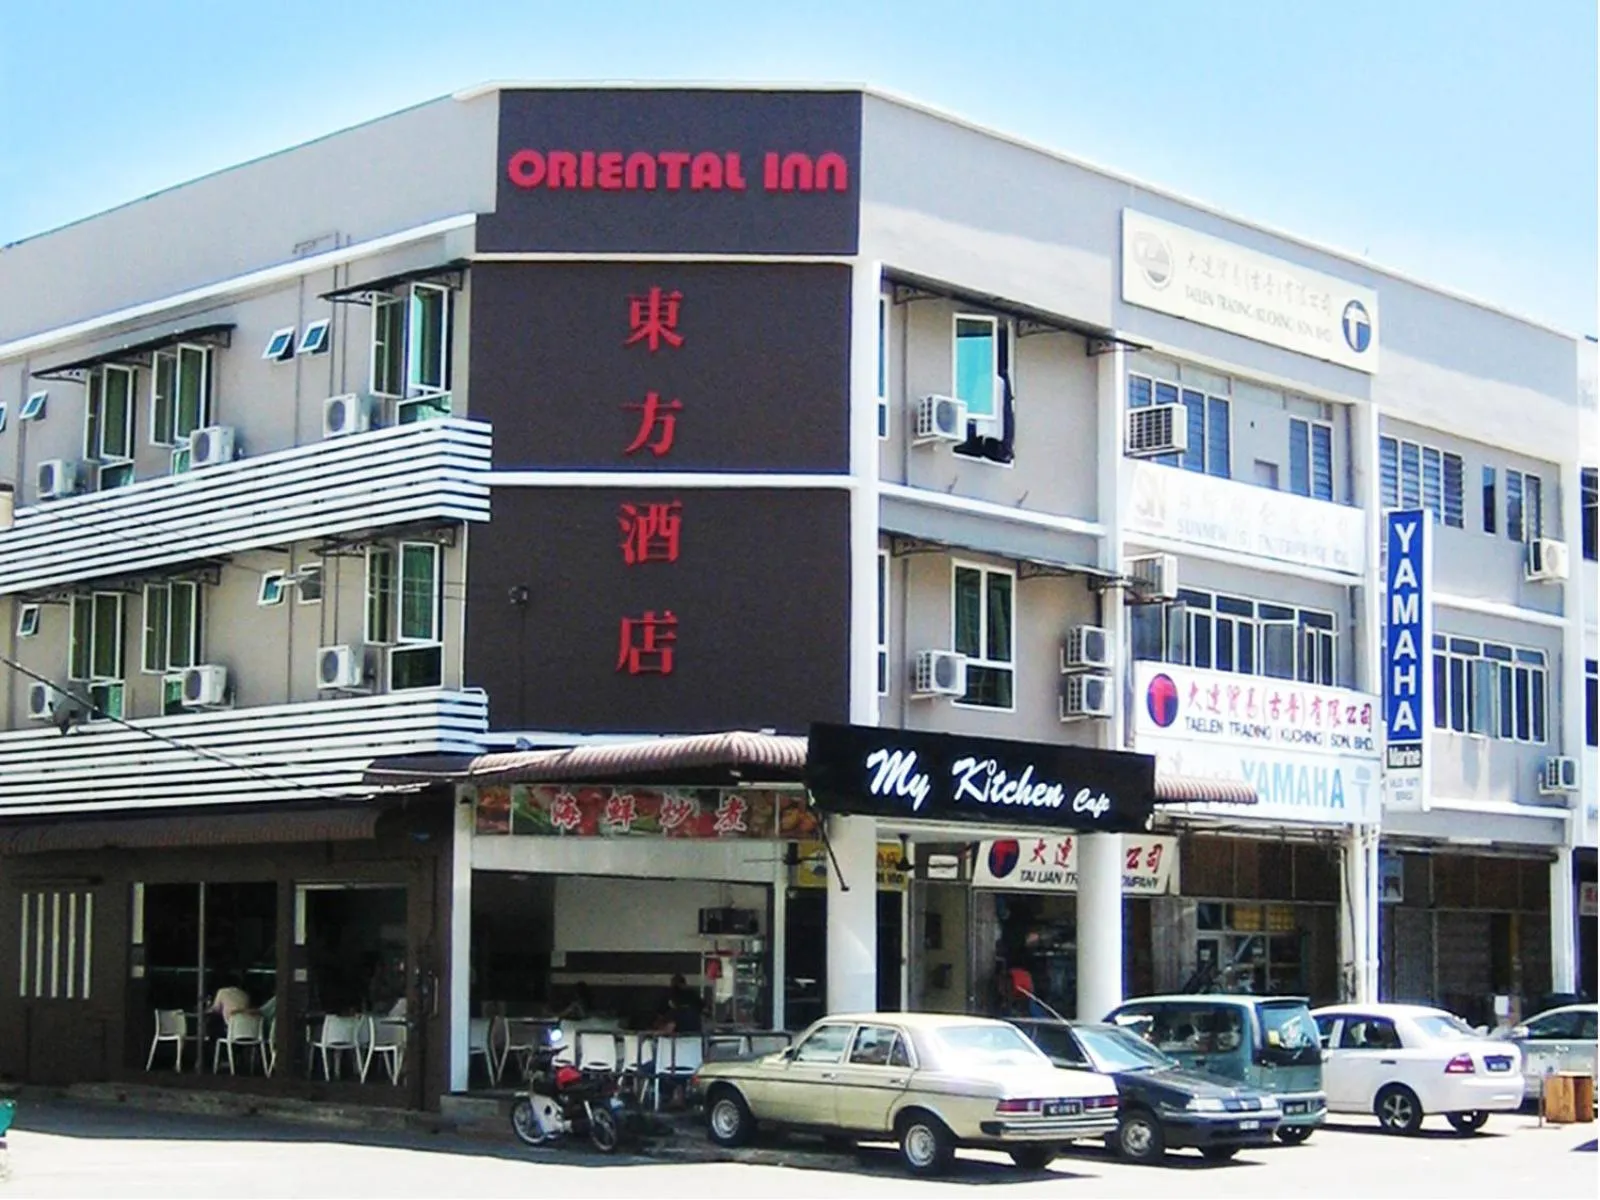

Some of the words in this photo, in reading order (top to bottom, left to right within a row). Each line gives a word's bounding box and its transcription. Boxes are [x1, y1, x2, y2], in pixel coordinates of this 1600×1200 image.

[508, 150, 746, 191] ORIENTAL
[763, 152, 848, 192] INN
[617, 286, 683, 675] 東方酒店
[1392, 521, 1419, 733] YAMAHA
[1229, 722, 1272, 741] TRADING
[866, 748, 930, 810] My
[952, 754, 1065, 810] Kitchen
[1072, 787, 1111, 818] Cafe
[1240, 758, 1346, 809] YAMAHA
